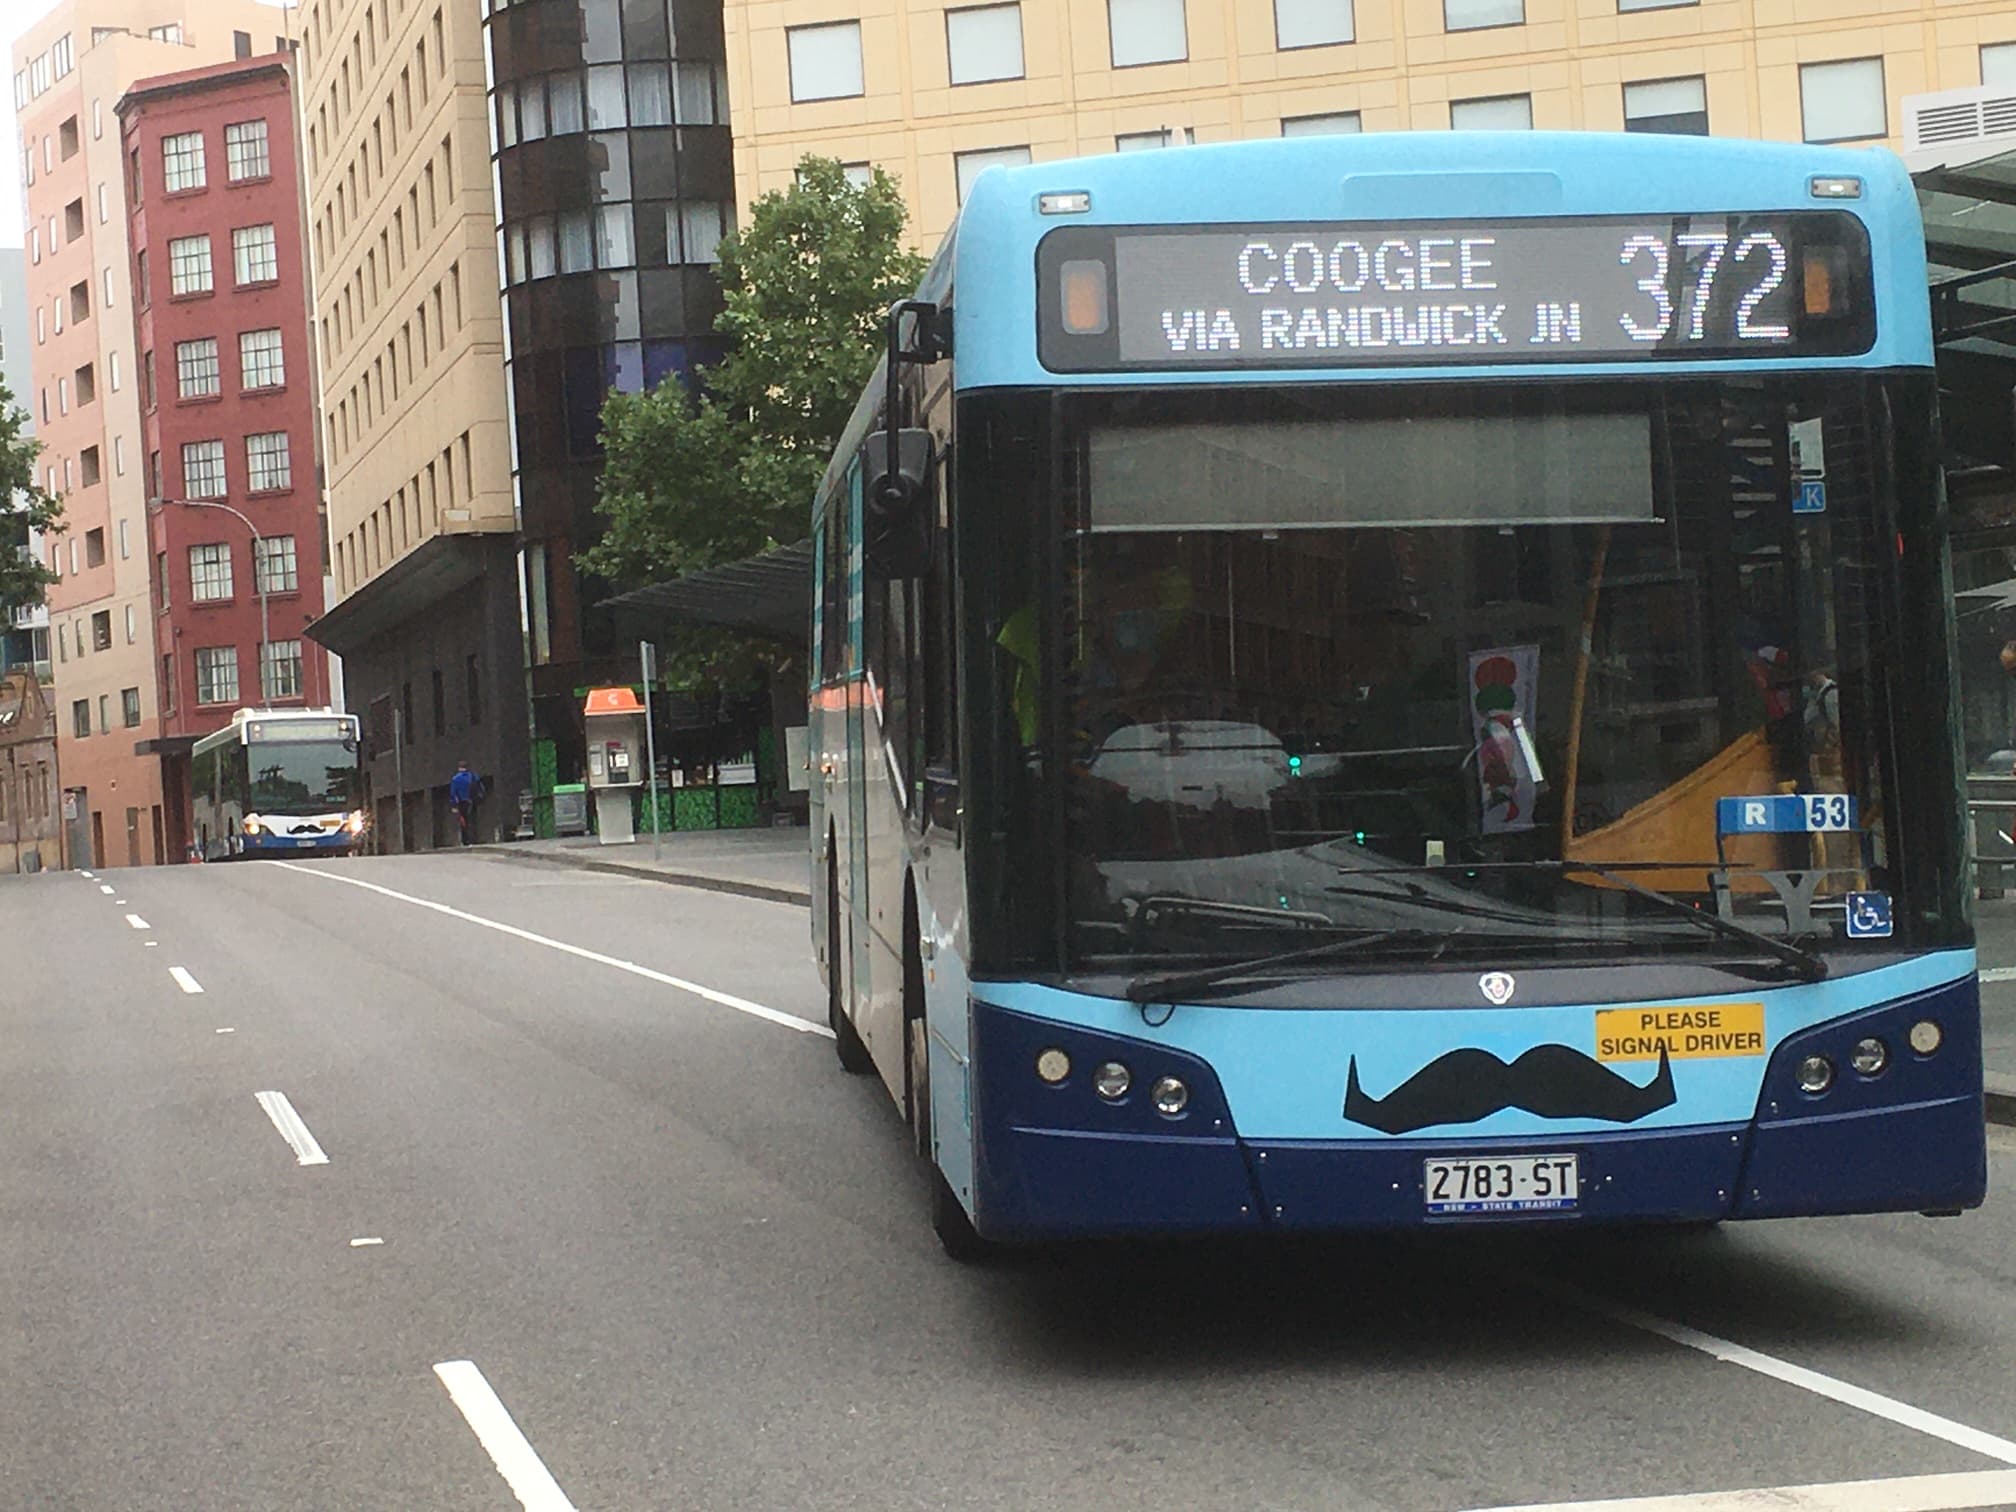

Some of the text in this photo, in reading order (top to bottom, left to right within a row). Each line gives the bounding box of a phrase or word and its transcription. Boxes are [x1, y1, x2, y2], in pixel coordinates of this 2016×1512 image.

[1238, 239, 1498, 294] COOGEE
[1619, 232, 1790, 340] 372
[1161, 303, 1582, 351] VIA RANDWICK JN
[1805, 486, 1822, 507] K
[1744, 796, 1847, 828] R 53
[1640, 1011, 1722, 1031] PLEASE
[1600, 1032, 1762, 1056] SIGNAL DRIVER
